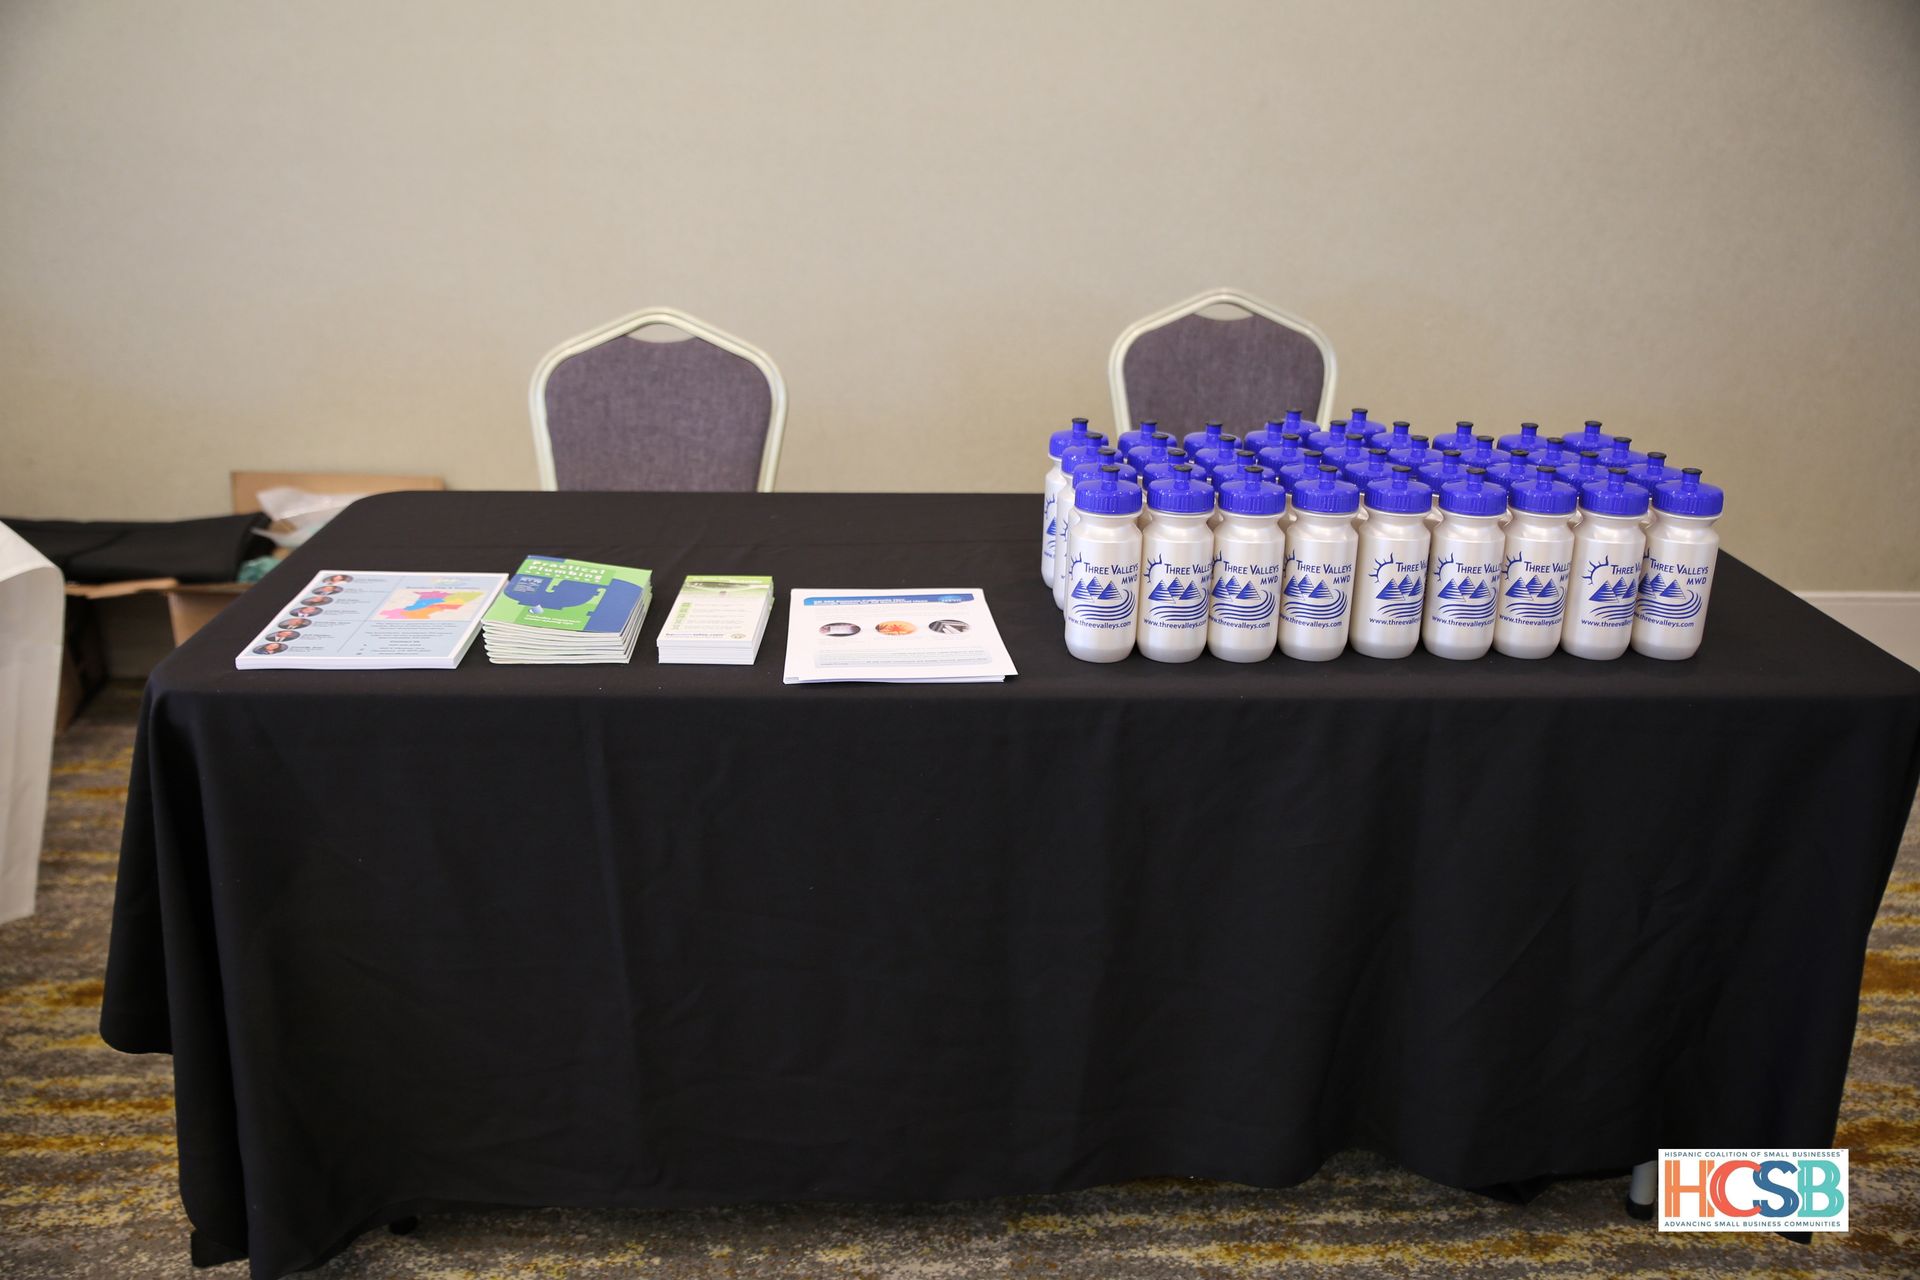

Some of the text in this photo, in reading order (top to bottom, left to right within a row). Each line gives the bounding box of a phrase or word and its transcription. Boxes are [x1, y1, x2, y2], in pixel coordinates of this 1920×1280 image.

[1083, 562, 1139, 575] THREE VALLEYS
[1164, 563, 1191, 575] THREE
[1223, 561, 1279, 575] THREE VALLEYS
[1296, 560, 1352, 574] THREE VALLEYS
[1395, 562, 1420, 572] THREE
[1456, 562, 1483, 574] THREE
[1524, 561, 1551, 573] THREE
[1610, 564, 1634, 575] THREE
[1650, 558, 1675, 573] THREE
[1677, 564, 1709, 575] VALLEYS
[1260, 575, 1279, 585] MWD
[1333, 575, 1351, 584] MWD
[1686, 577, 1707, 585] MWD
